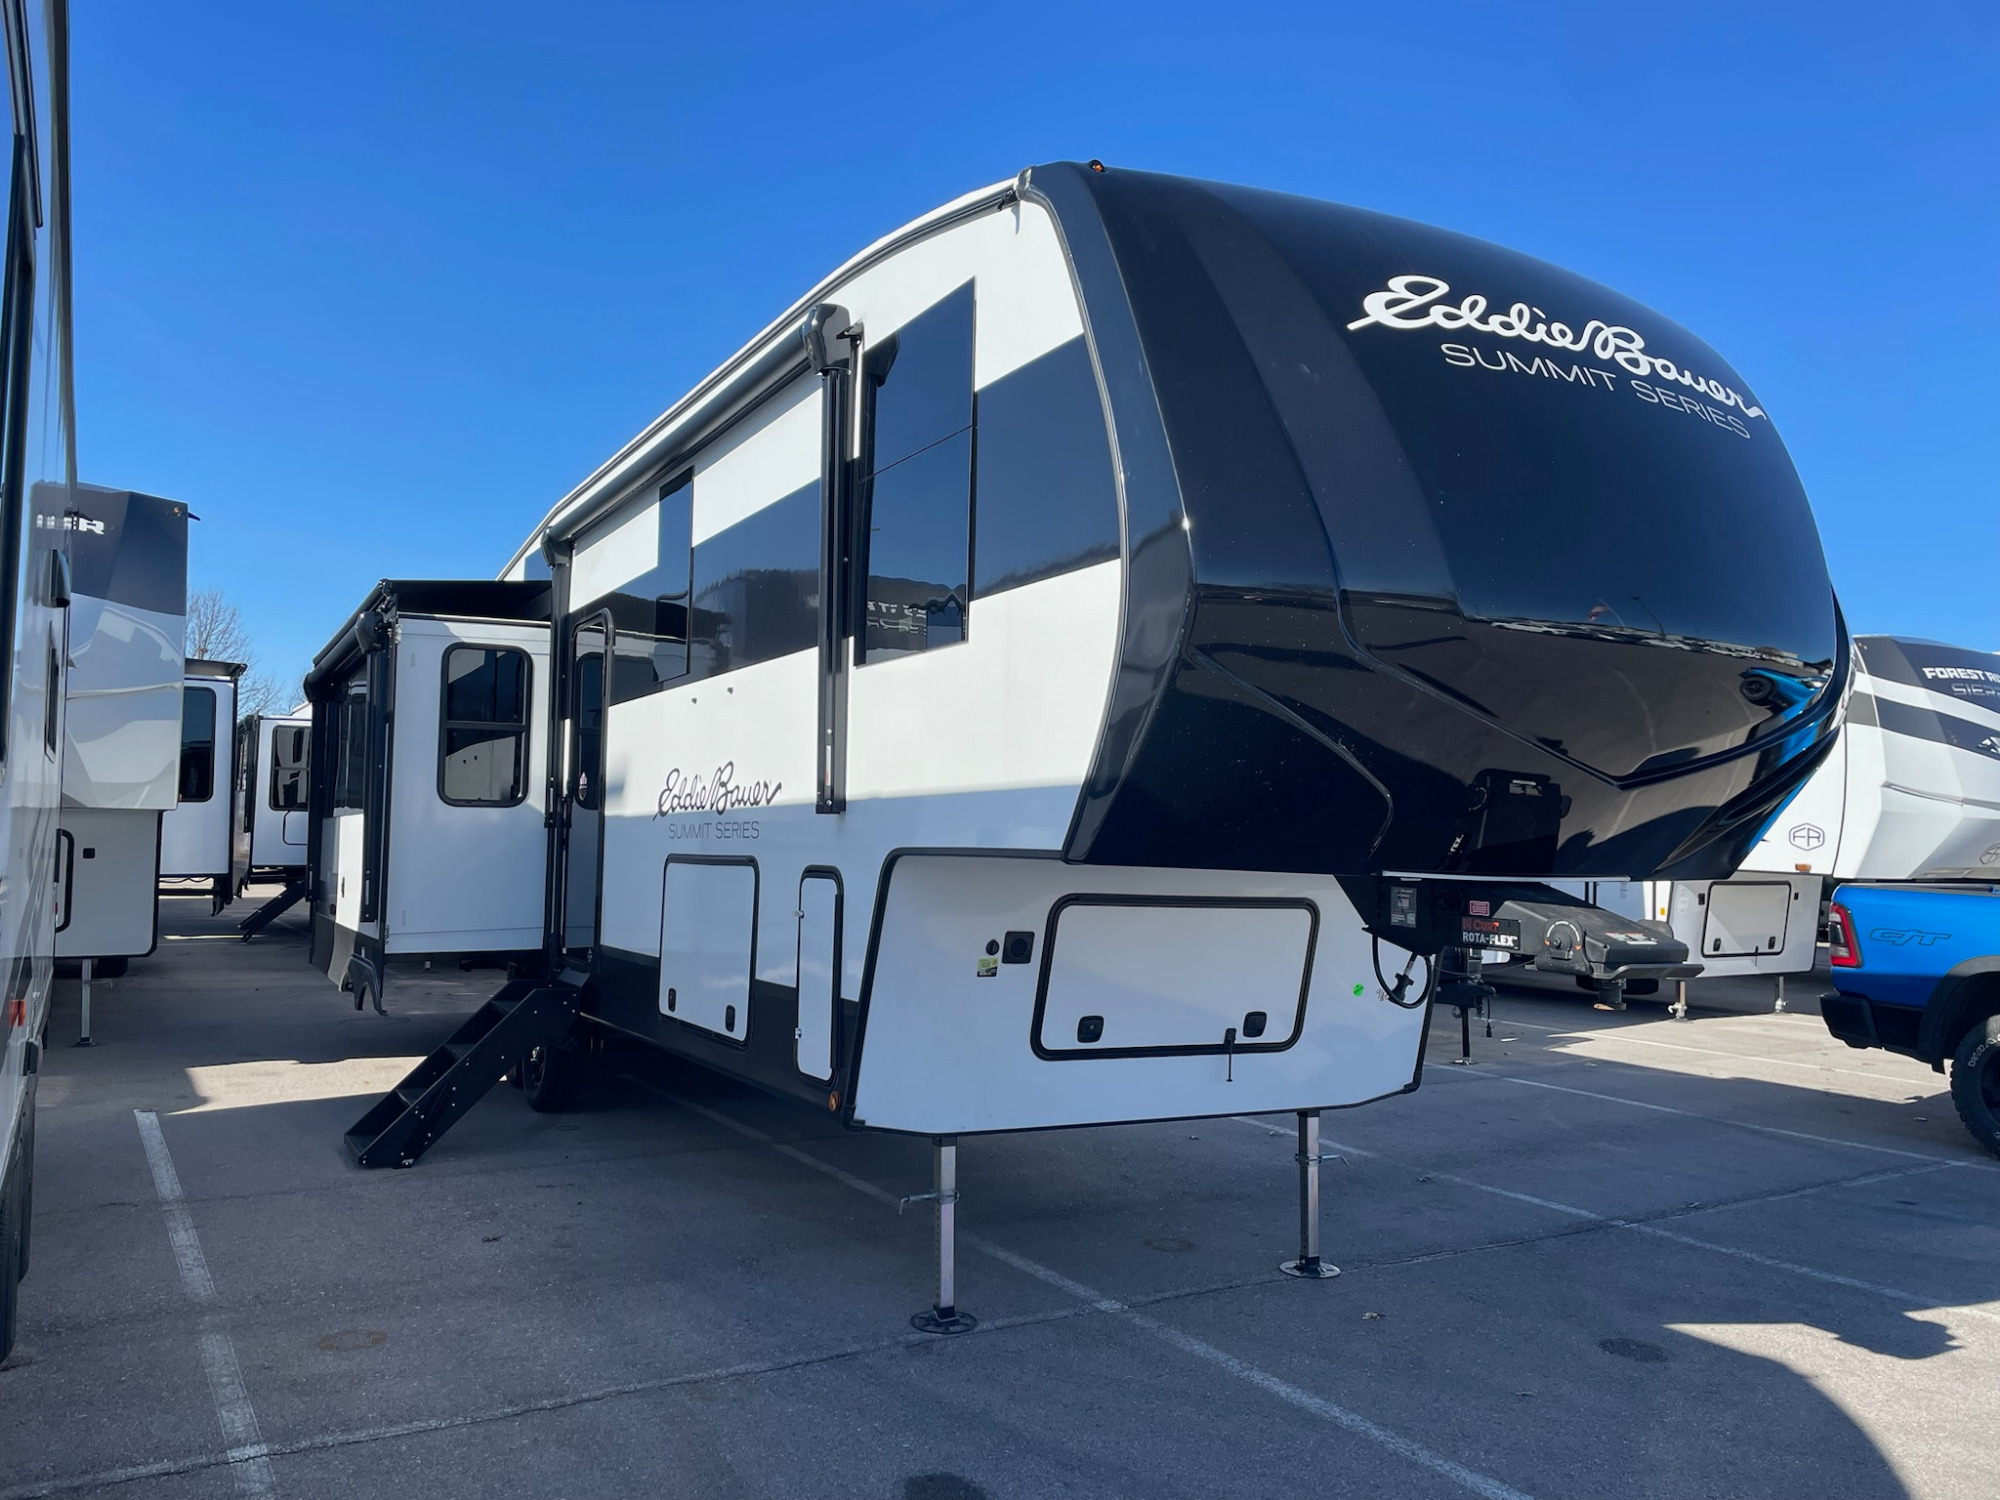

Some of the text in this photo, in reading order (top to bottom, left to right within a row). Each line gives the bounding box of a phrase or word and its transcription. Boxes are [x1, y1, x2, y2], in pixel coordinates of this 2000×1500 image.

[1347, 275, 1767, 420] Eddie Bauer
[1440, 343, 1752, 440] SUMMIT SERIES
[1922, 667, 1985, 680] FOREST
[652, 760, 782, 822] Eddie Bauer
[668, 820, 760, 840] SUMMIT SERIES
